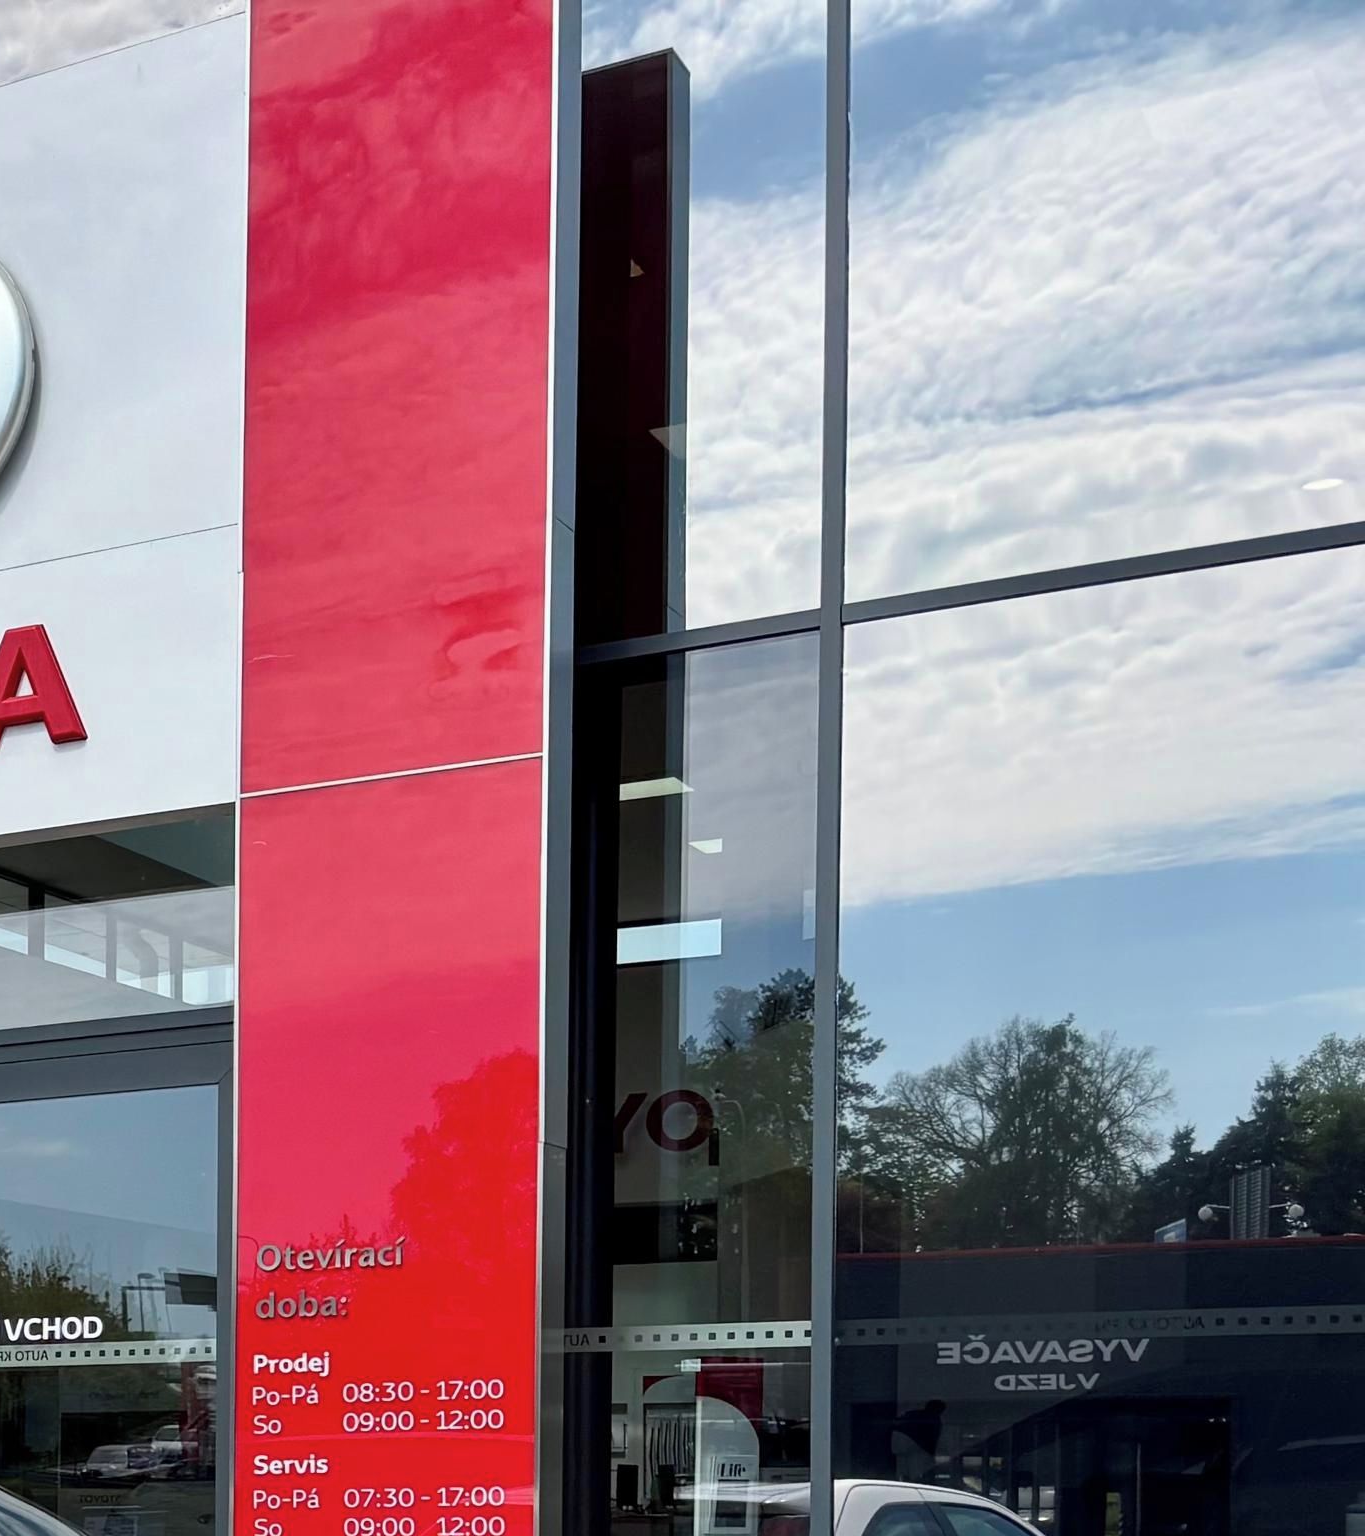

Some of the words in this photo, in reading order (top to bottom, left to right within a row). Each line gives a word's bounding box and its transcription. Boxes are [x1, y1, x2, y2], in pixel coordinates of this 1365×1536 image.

[256, 1237, 406, 1272] Otevírací
[255, 1289, 348, 1319] doba:
[4, 1316, 103, 1342] VCHOD
[253, 1352, 330, 1377] Prodej
[252, 1383, 319, 1406] Po-Pá
[342, 1381, 414, 1403] 08:30
[436, 1379, 504, 1401] 17:00
[252, 1414, 282, 1435] So
[342, 1411, 414, 1432] 09:00
[436, 1409, 504, 1430] 12:00
[253, 1453, 329, 1475] Servis
[252, 1487, 320, 1510] Po-Pá
[343, 1487, 415, 1509] 07:30
[437, 1486, 505, 1507] 17:00
[343, 1517, 415, 1536] 09:00
[436, 1516, 506, 1536] 12:00
